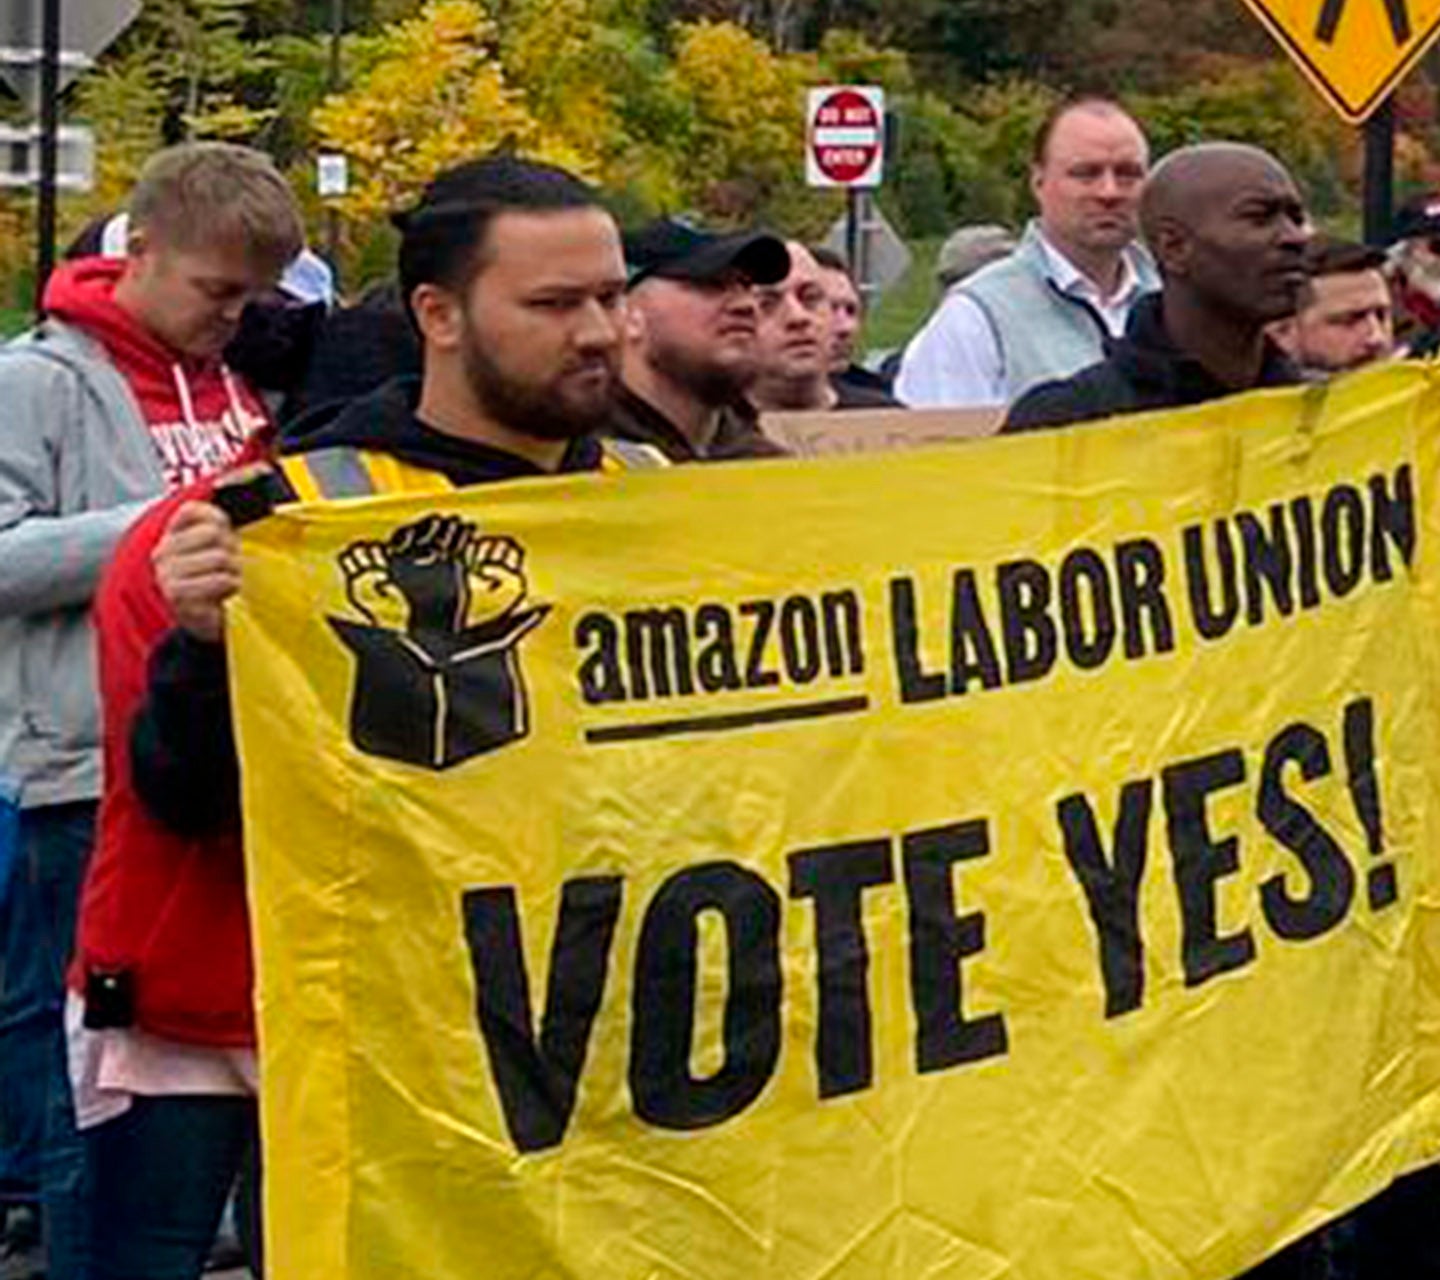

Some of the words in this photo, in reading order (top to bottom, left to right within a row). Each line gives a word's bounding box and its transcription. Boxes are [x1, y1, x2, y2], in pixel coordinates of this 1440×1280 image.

[818, 106, 839, 124] DO
[844, 106, 871, 123] NOT
[823, 149, 867, 167] ENTER
[573, 588, 865, 706] amazon
[889, 537, 1175, 705] LABOR
[1182, 462, 1417, 642] UNION
[460, 818, 1010, 1157] VOTE
[1055, 696, 1400, 1020] YES!
